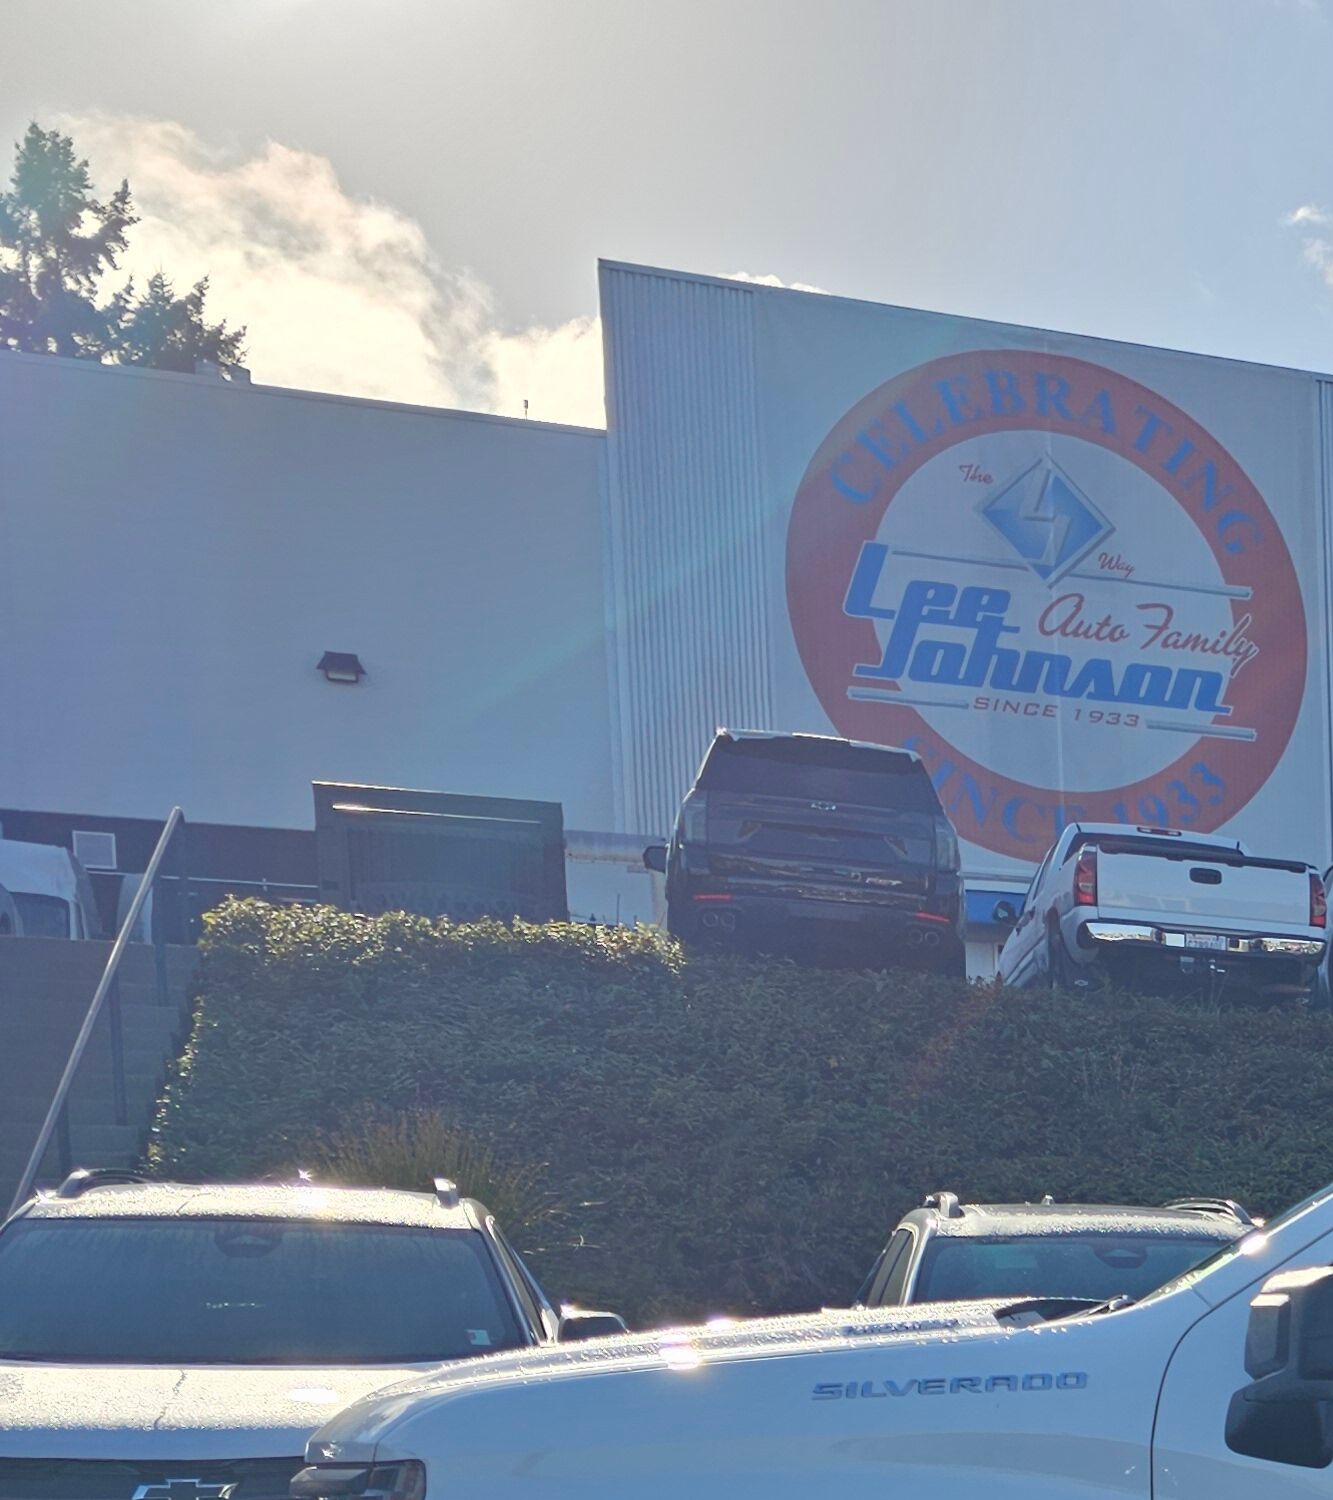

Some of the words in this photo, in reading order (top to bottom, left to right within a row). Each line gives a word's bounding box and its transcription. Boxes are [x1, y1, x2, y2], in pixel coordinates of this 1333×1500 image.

[828, 367, 1264, 558] CELEBRATING
[958, 463, 994, 485] The
[845, 542, 1021, 634] Lee
[1097, 551, 1136, 578] Way
[855, 612, 1232, 715] Johnson
[1037, 592, 1131, 643] Auto
[1136, 602, 1258, 675] Family
[974, 696, 1059, 718] SINCE
[1072, 707, 1141, 729] 1933
[1113, 760, 1228, 827] 1933
[811, 1371, 1089, 1401] SILVERADO
